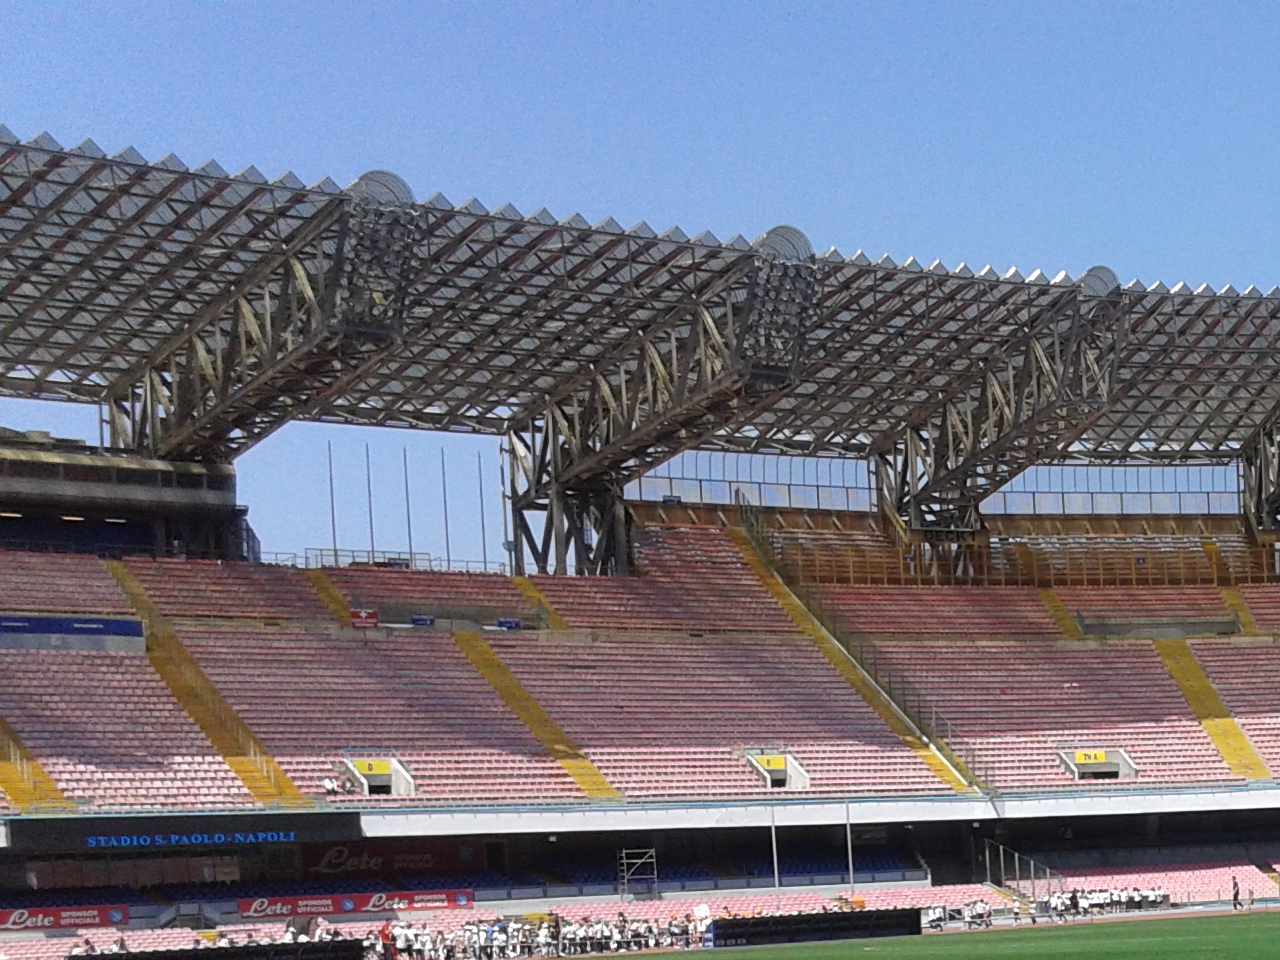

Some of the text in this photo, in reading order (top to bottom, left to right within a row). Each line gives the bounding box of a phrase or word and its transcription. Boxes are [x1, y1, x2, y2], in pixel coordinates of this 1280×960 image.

[87, 835, 151, 847] STADIO
[242, 898, 293, 917] Lete
[362, 893, 409, 911] Lete
[0, 909, 55, 929] Lete
